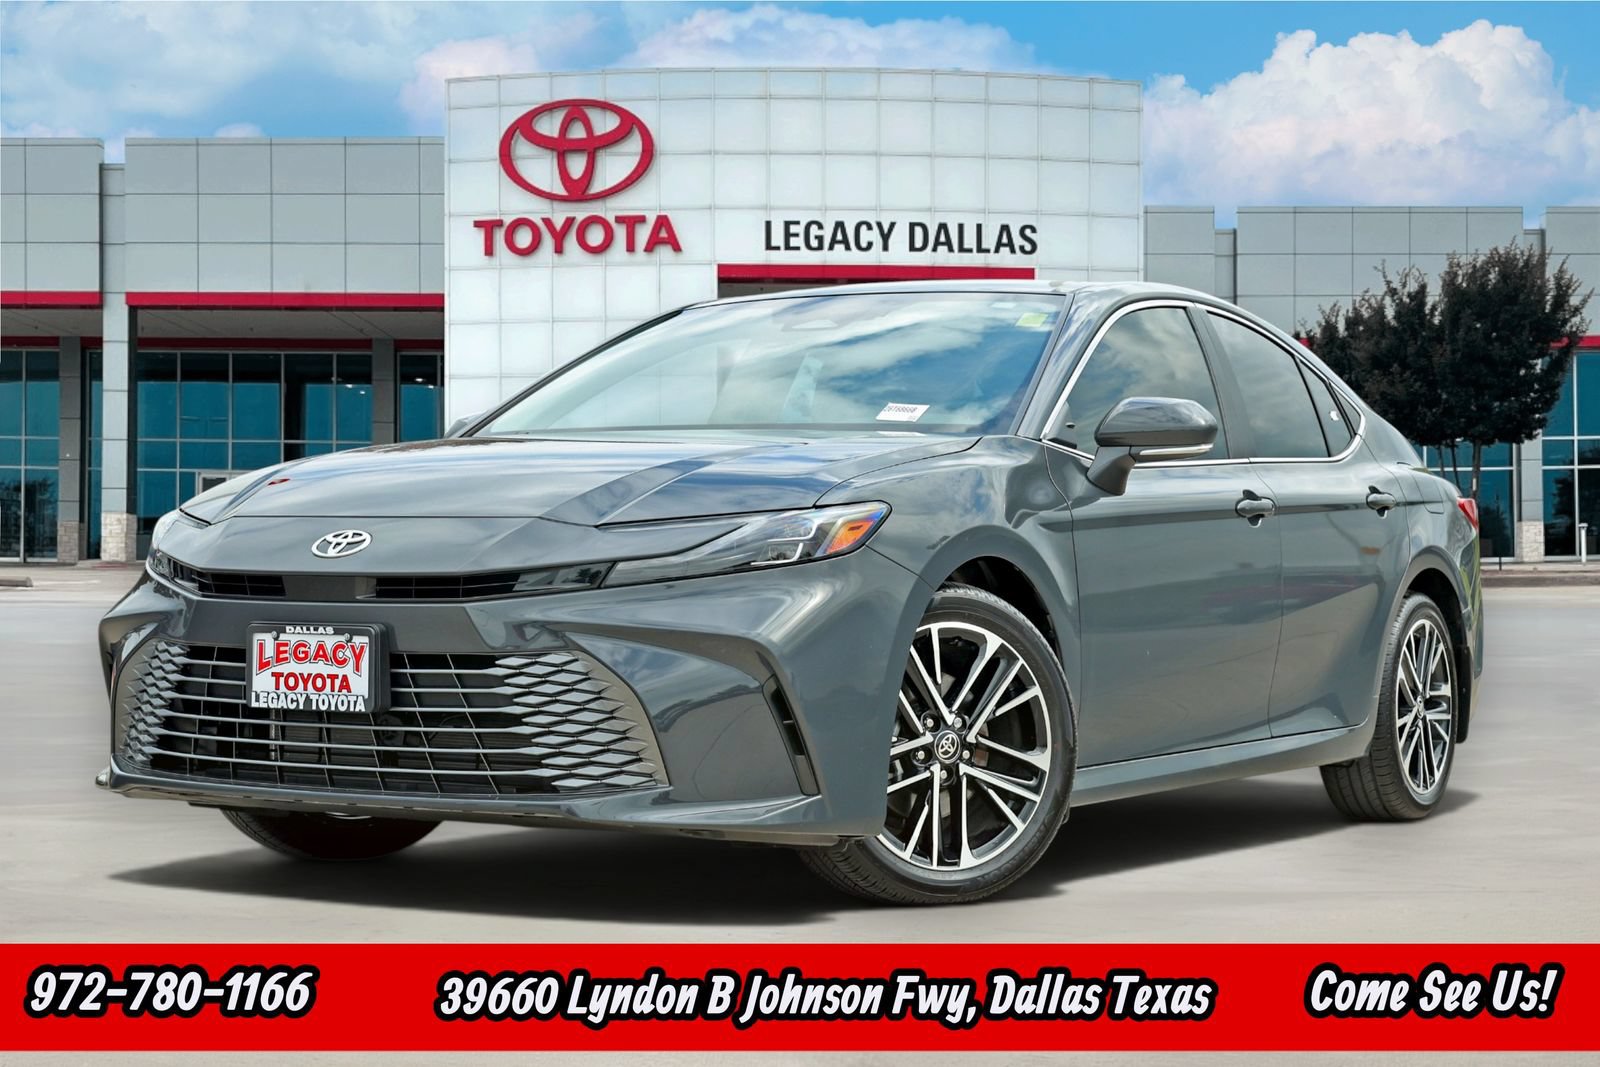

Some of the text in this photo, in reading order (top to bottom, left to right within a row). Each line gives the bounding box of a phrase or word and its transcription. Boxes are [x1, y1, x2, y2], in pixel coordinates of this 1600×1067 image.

[474, 215, 682, 257] TOYOTA
[764, 220, 1038, 255] LEGACY DALLAS
[285, 626, 334, 634] DALLAS
[256, 639, 368, 677] LEGACY
[271, 672, 352, 693] TOYOTA
[251, 691, 365, 712] LEGACY TOYOTA
